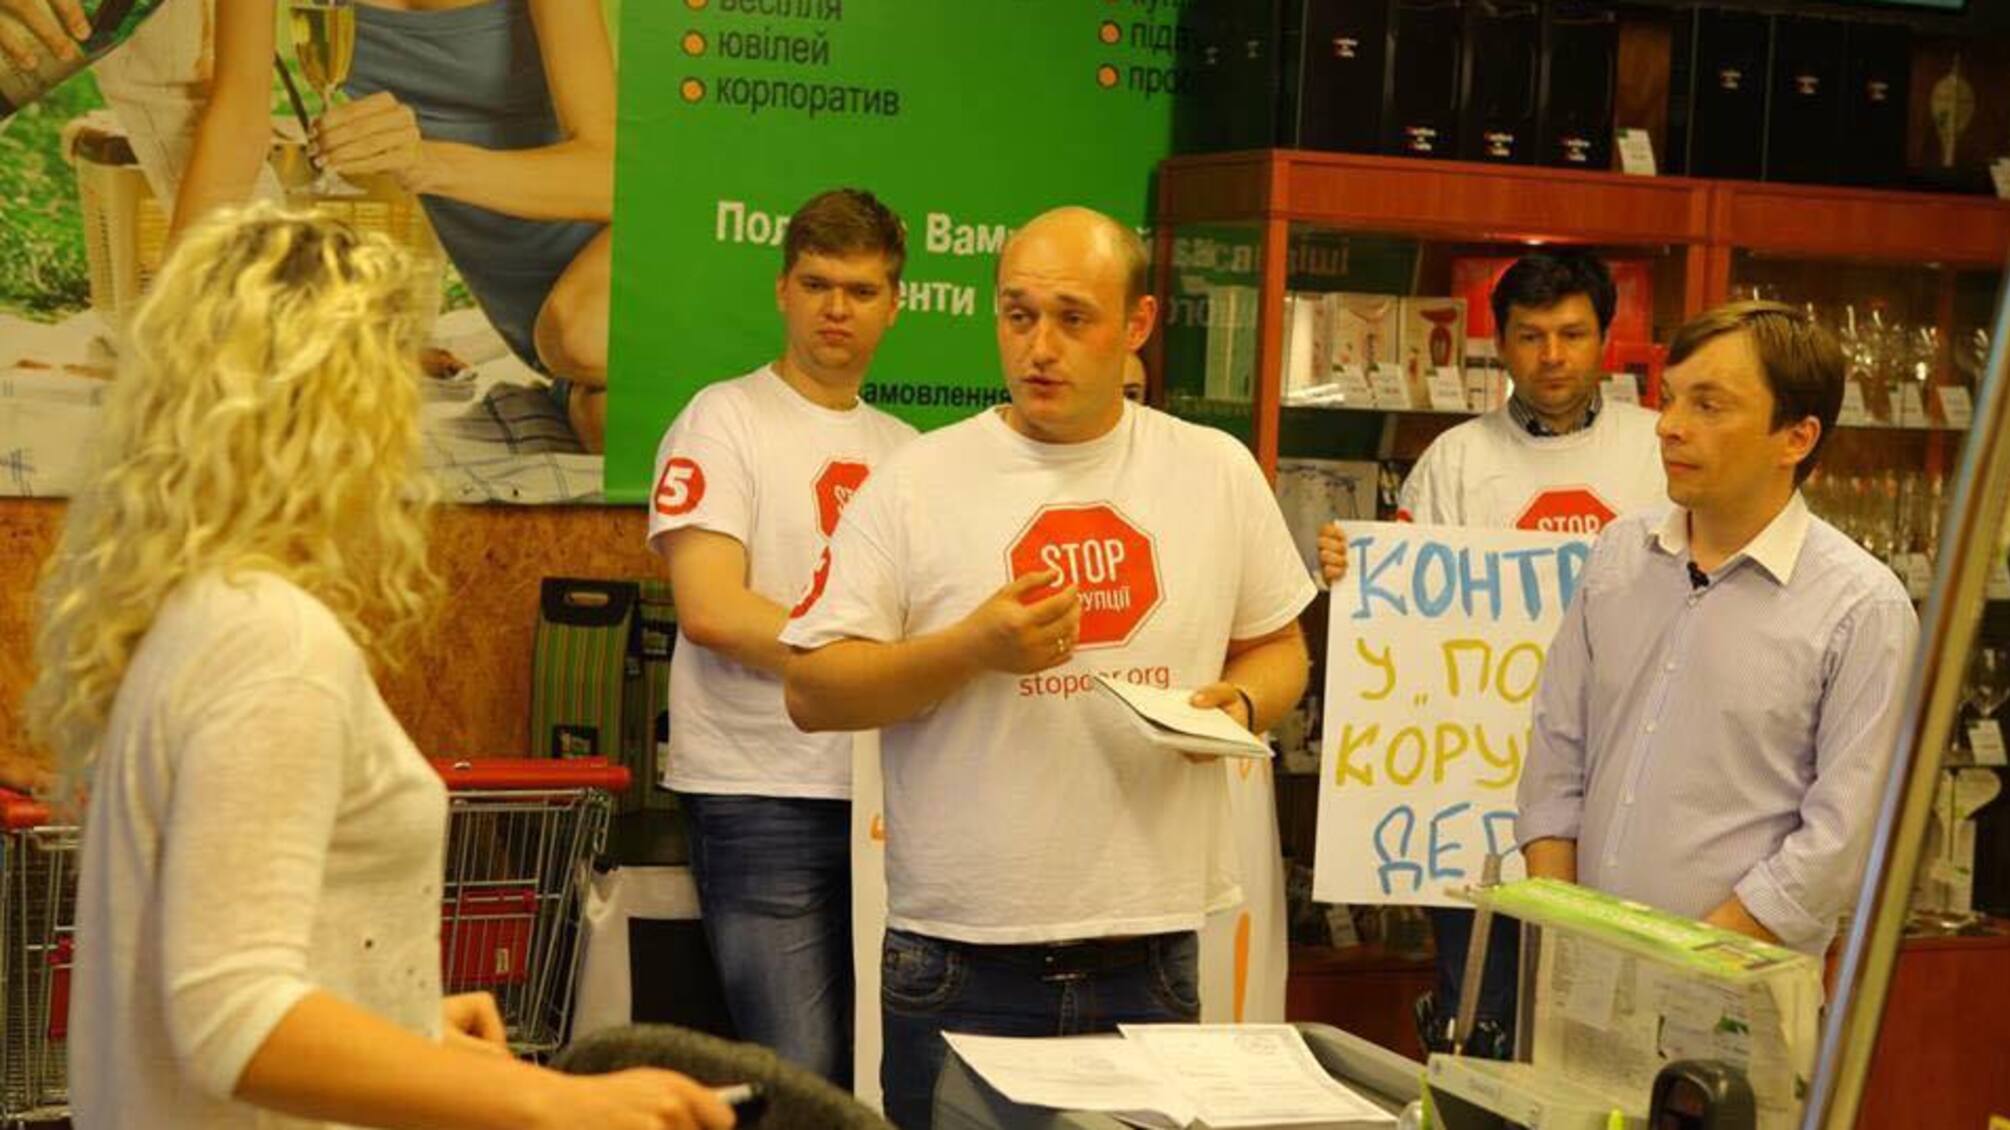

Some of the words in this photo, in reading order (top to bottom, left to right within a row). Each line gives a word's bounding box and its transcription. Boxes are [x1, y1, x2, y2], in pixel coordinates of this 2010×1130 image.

[719, 26, 830, 66] ювілей
[716, 76, 900, 119] корпоратив
[926, 212, 1014, 256] Вам
[859, 382, 1013, 408] амовлення
[656, 465, 695, 506] 5
[1040, 538, 1126, 588] STOP
[1335, 721, 1532, 790] КОРУ
